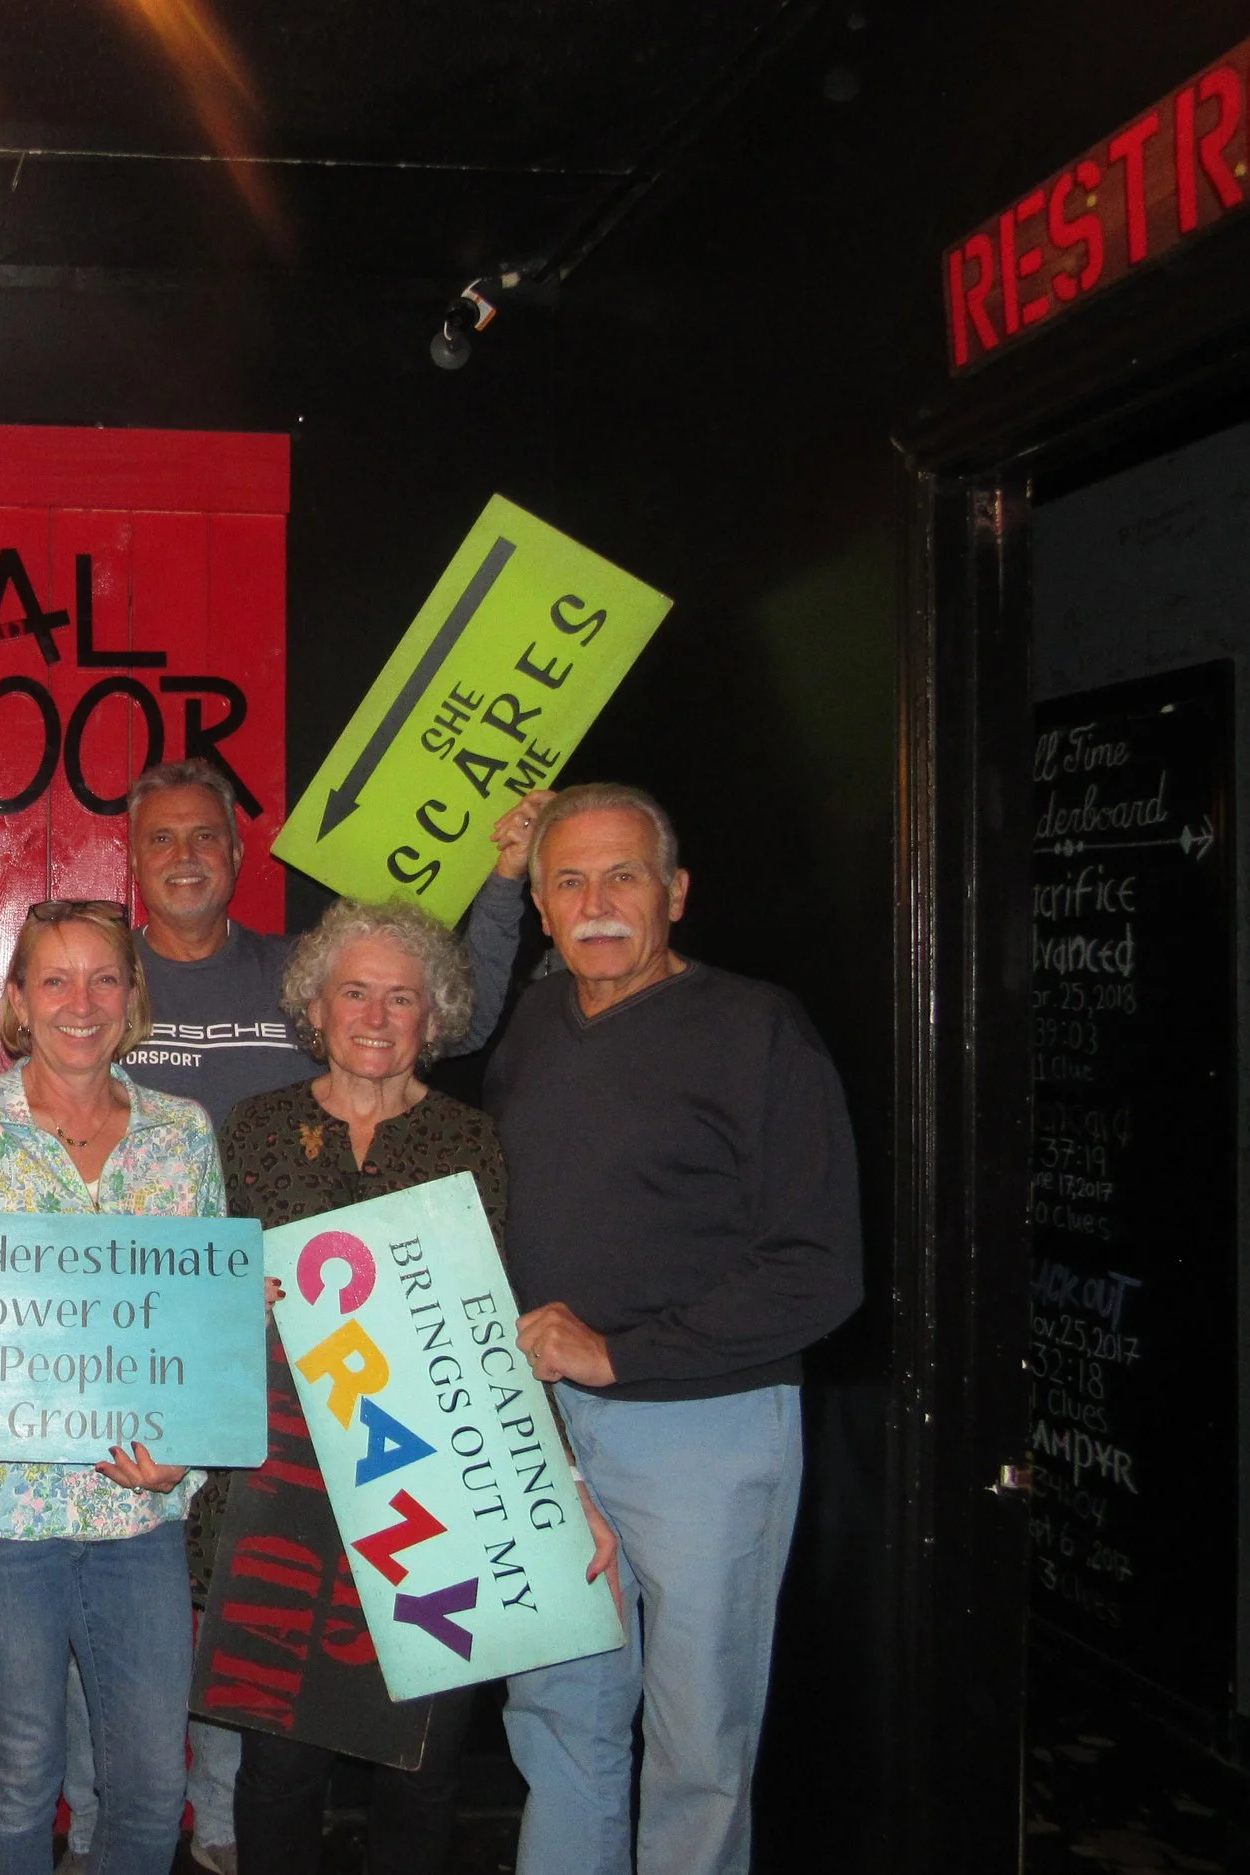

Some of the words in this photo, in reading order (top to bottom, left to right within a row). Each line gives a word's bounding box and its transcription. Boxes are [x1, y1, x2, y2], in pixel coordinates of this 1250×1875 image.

[950, 66, 1250, 367] RESTR
[387, 594, 607, 896] SCARES
[421, 681, 485, 760] SHE
[1033, 729, 1061, 783] ll
[1062, 722, 1131, 773] Time
[503, 737, 561, 798] ME
[1033, 769, 1169, 840] derboard
[1033, 864, 1137, 921] crifice
[120, 1050, 202, 1068] ORSPORT
[150, 1022, 287, 1040] RSCHE
[112, 1290, 161, 1330] of
[0, 1345, 138, 1394] People
[148, 1349, 184, 1386] in
[7, 1401, 165, 1444] Groups
[388, 1234, 472, 1416] BRINGS
[450, 1424, 509, 1524] OUT
[483, 1536, 538, 1615] MY
[460, 1289, 566, 1531] ESCAPING
[294, 1230, 479, 1662] CRAZY
[1031, 1419, 1140, 1498] AMPYR
[204, 1535, 323, 1732] MAD
